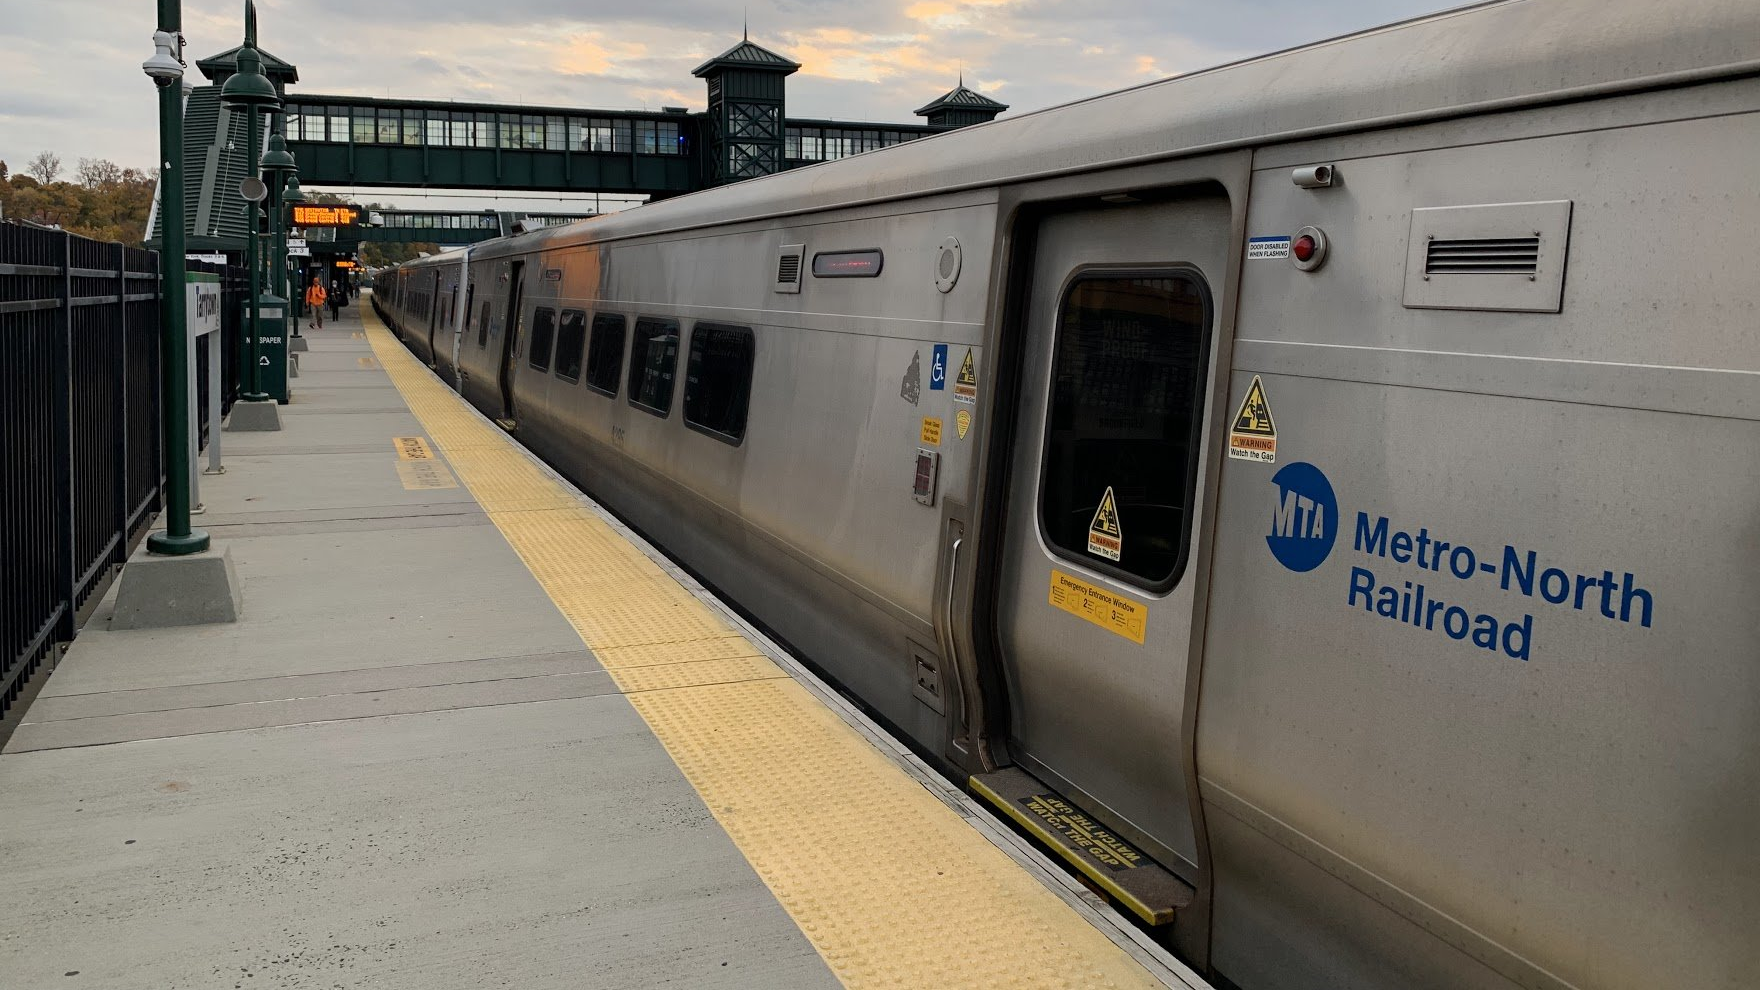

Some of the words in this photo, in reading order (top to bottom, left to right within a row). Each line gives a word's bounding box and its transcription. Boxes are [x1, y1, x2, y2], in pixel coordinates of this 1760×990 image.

[246, 336, 281, 344] NSPAPER
[1240, 438, 1272, 449] WARNING
[1231, 447, 1248, 457] Watch
[1250, 450, 1259, 458] the
[1261, 452, 1273, 462] Gap
[1272, 489, 1324, 540] MTA
[1090, 543, 1101, 553] Watch
[1110, 550, 1119, 559] Gap
[1096, 536, 1118, 550] WARNING
[1354, 511, 1653, 628] Metro-North
[1060, 577, 1088, 595] Emergency
[1088, 588, 1111, 604] Entrance
[1113, 597, 1134, 613] Window
[1083, 598, 1088, 608] 2
[1112, 610, 1116, 620] 3
[1348, 566, 1532, 661] Railroad
[1047, 798, 1074, 814] GAP
[1070, 814, 1097, 831] THE
[1027, 801, 1067, 829] WATCH
[1064, 828, 1092, 847] THE
[1088, 847, 1120, 865] GAP
[1093, 831, 1141, 861] WATCH
